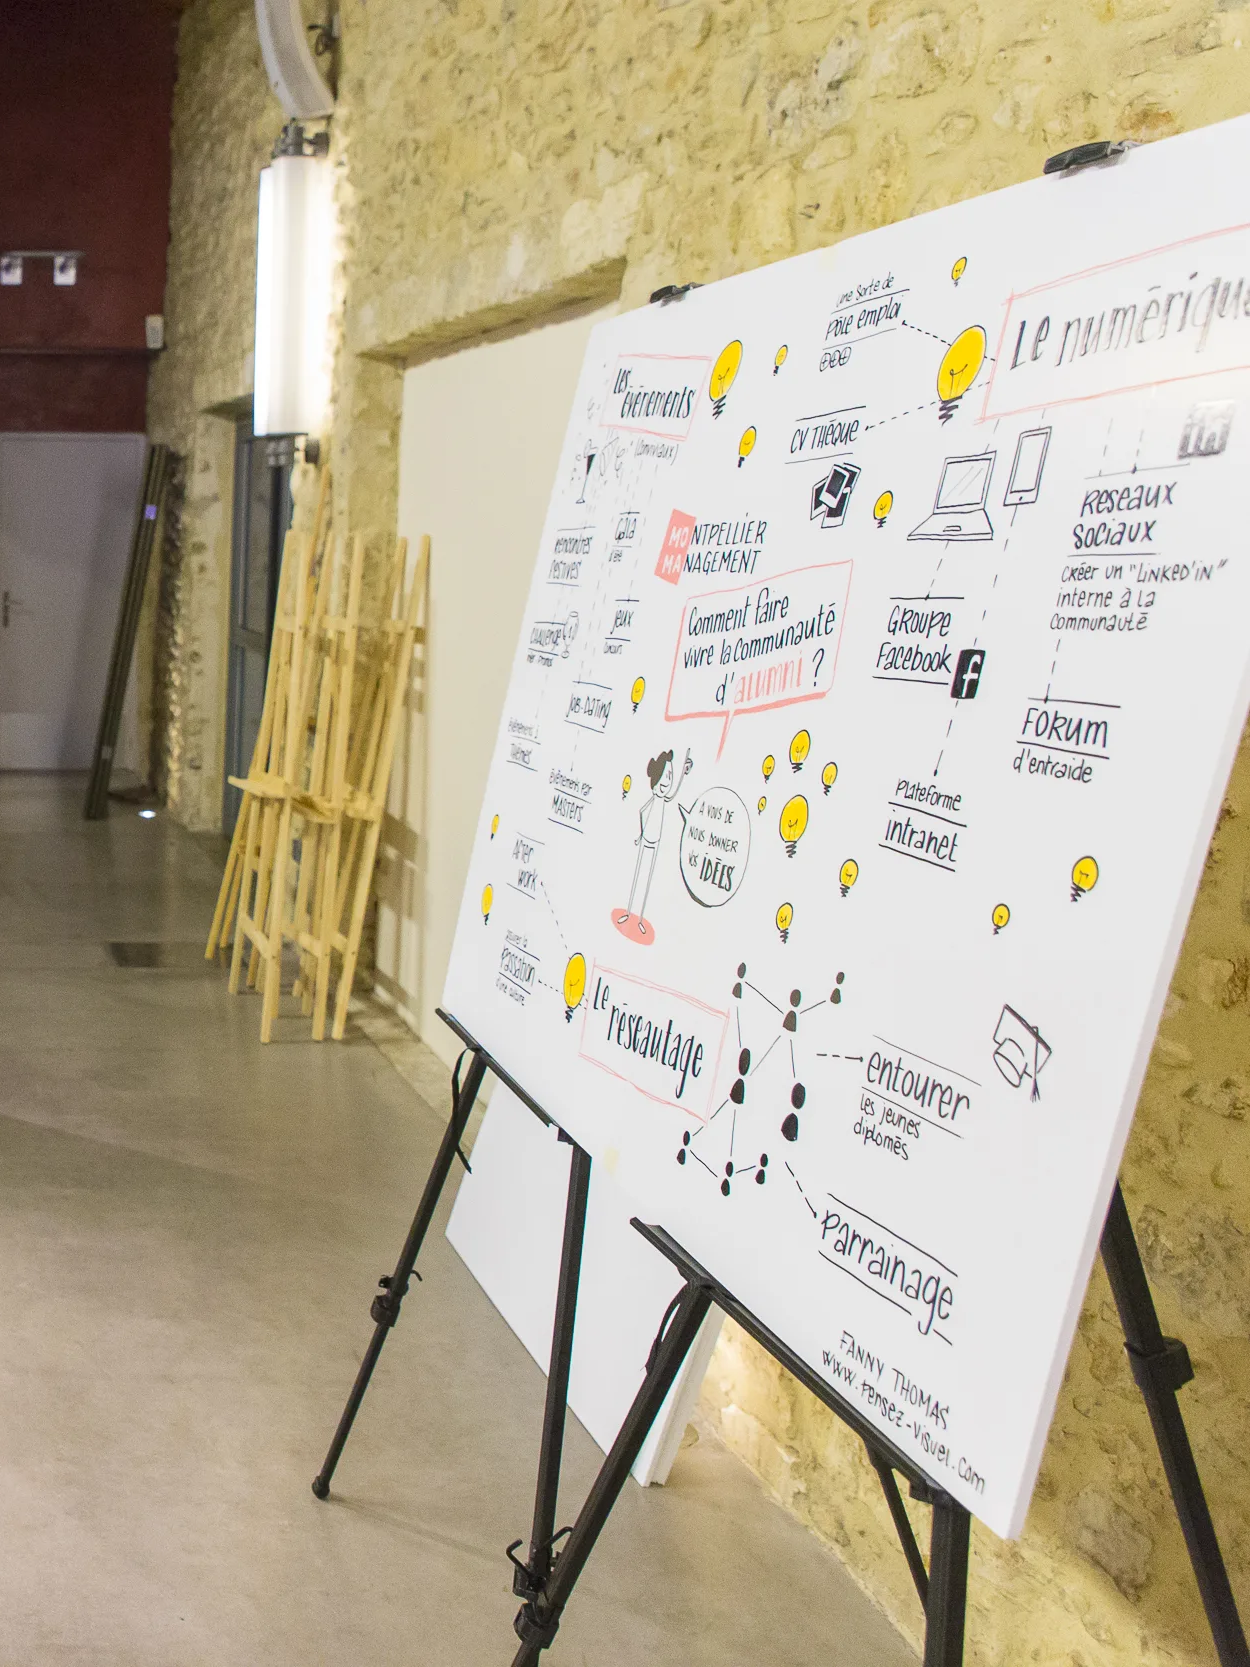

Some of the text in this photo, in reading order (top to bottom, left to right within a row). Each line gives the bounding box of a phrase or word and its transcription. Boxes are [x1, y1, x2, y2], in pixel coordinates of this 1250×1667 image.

[881, 271, 895, 290] de
[857, 294, 905, 330] emploi
[1010, 315, 1051, 371] Le
[790, 425, 809, 454] CV
[661, 548, 762, 576] MANAGEMENT
[1105, 564, 1123, 581] un
[687, 587, 790, 637] Comment faire
[1056, 587, 1157, 609] interne à la
[683, 645, 714, 670] vivre
[720, 638, 731, 666] la
[876, 641, 952, 674] Facebook
[715, 648, 825, 706] d'alumni ?
[1012, 748, 1094, 784] d'entraide
[707, 803, 723, 821] VOUS
[724, 810, 735, 825] DE
[687, 825, 739, 854] NOUS DONNER
[884, 808, 959, 863] intranet
[607, 1002, 704, 1100] réseautage
[866, 1051, 971, 1122] entourer
[878, 1102, 921, 1139] jeunes
[839, 1329, 950, 1431] FANNY THOMAS
